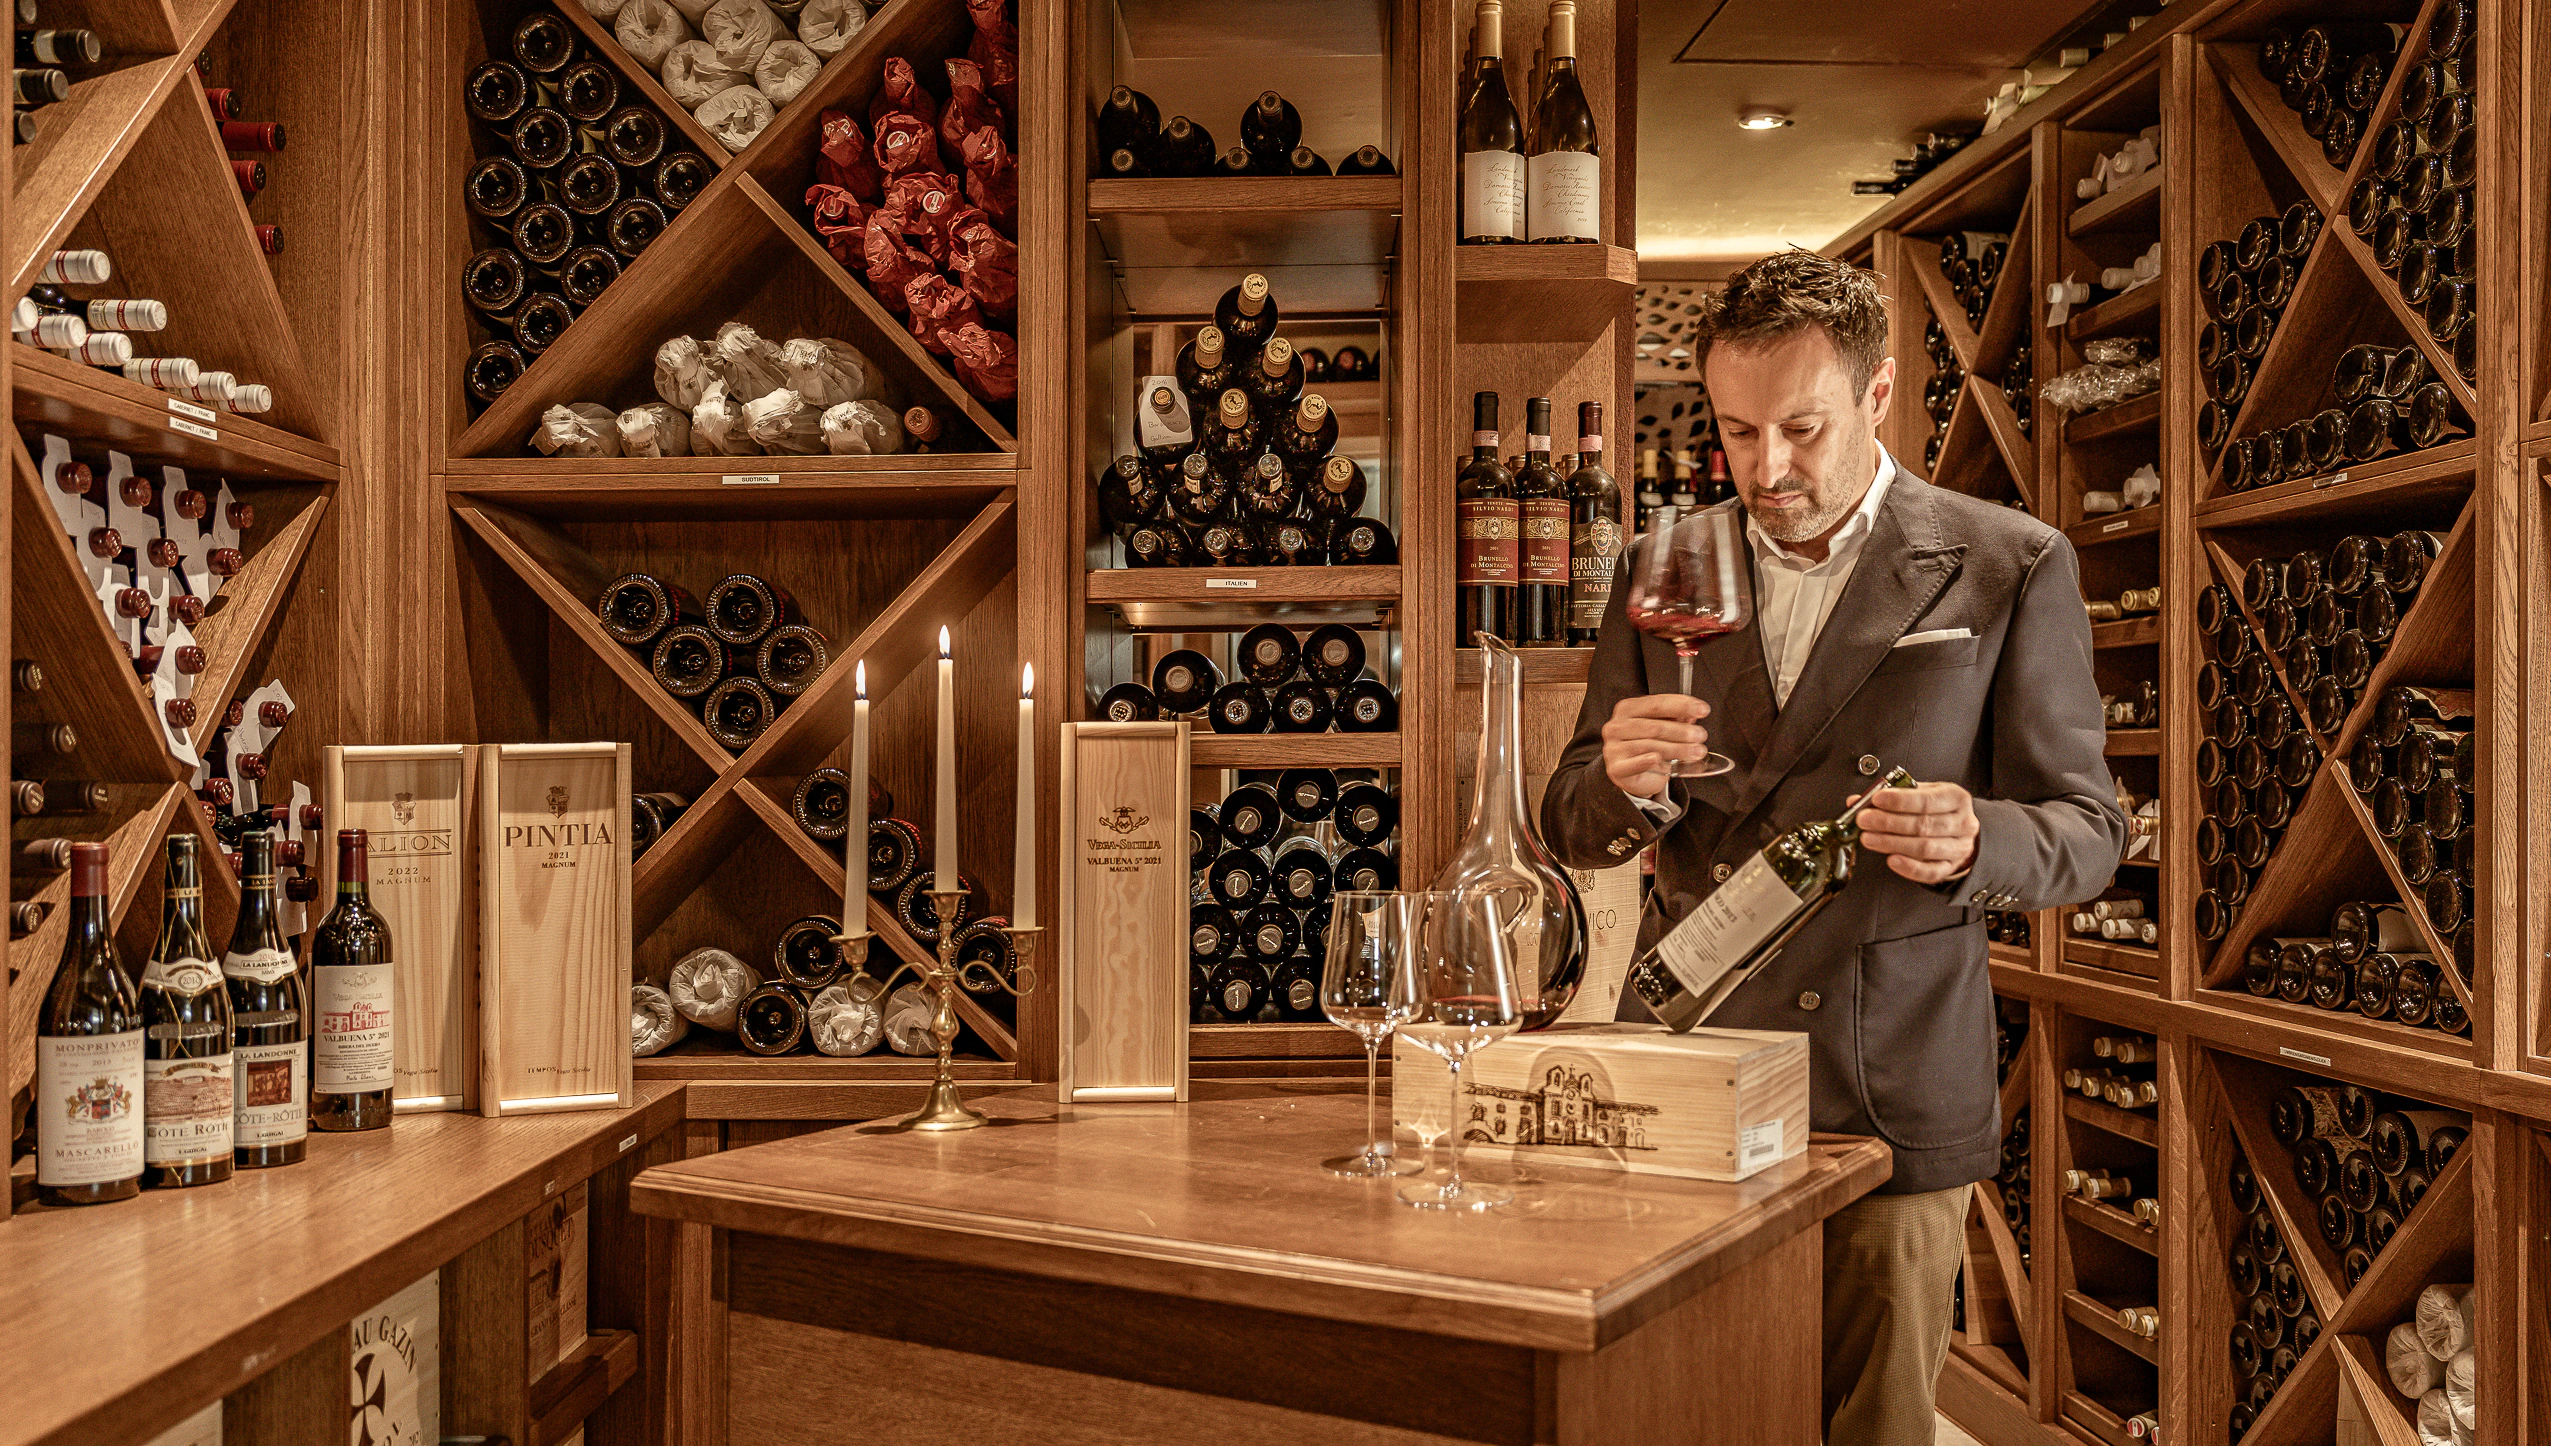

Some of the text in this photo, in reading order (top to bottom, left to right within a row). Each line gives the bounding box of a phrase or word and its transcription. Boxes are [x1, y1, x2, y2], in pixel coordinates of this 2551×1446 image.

[1546, 163, 1581, 174] Landmark
[1554, 206, 1584, 216] California
[1530, 561, 1565, 569] MONTALCINO
[1571, 557, 1618, 571] BRUNEL
[1584, 583, 1612, 593] NAR
[503, 822, 613, 848] PINTIA
[1087, 839, 1161, 850] VEGA-SICILIA
[548, 852, 570, 860] 2021
[1087, 857, 1133, 865] VALBUENA
[1144, 856, 1162, 865] 2021
[541, 861, 576, 869] MAGNUM
[388, 867, 420, 876] 2022
[376, 876, 432, 886] MAGNUM
[182, 976, 201, 985] 2010
[324, 1034, 367, 1042] VALBUENA
[55, 1039, 140, 1053] MONPRIVATO
[253, 1048, 297, 1059] LANDONNE
[528, 1066, 556, 1074] TEMPOS
[55, 1140, 139, 1158] MASCARELLO
[380, 1315, 417, 1374] GAZIN
